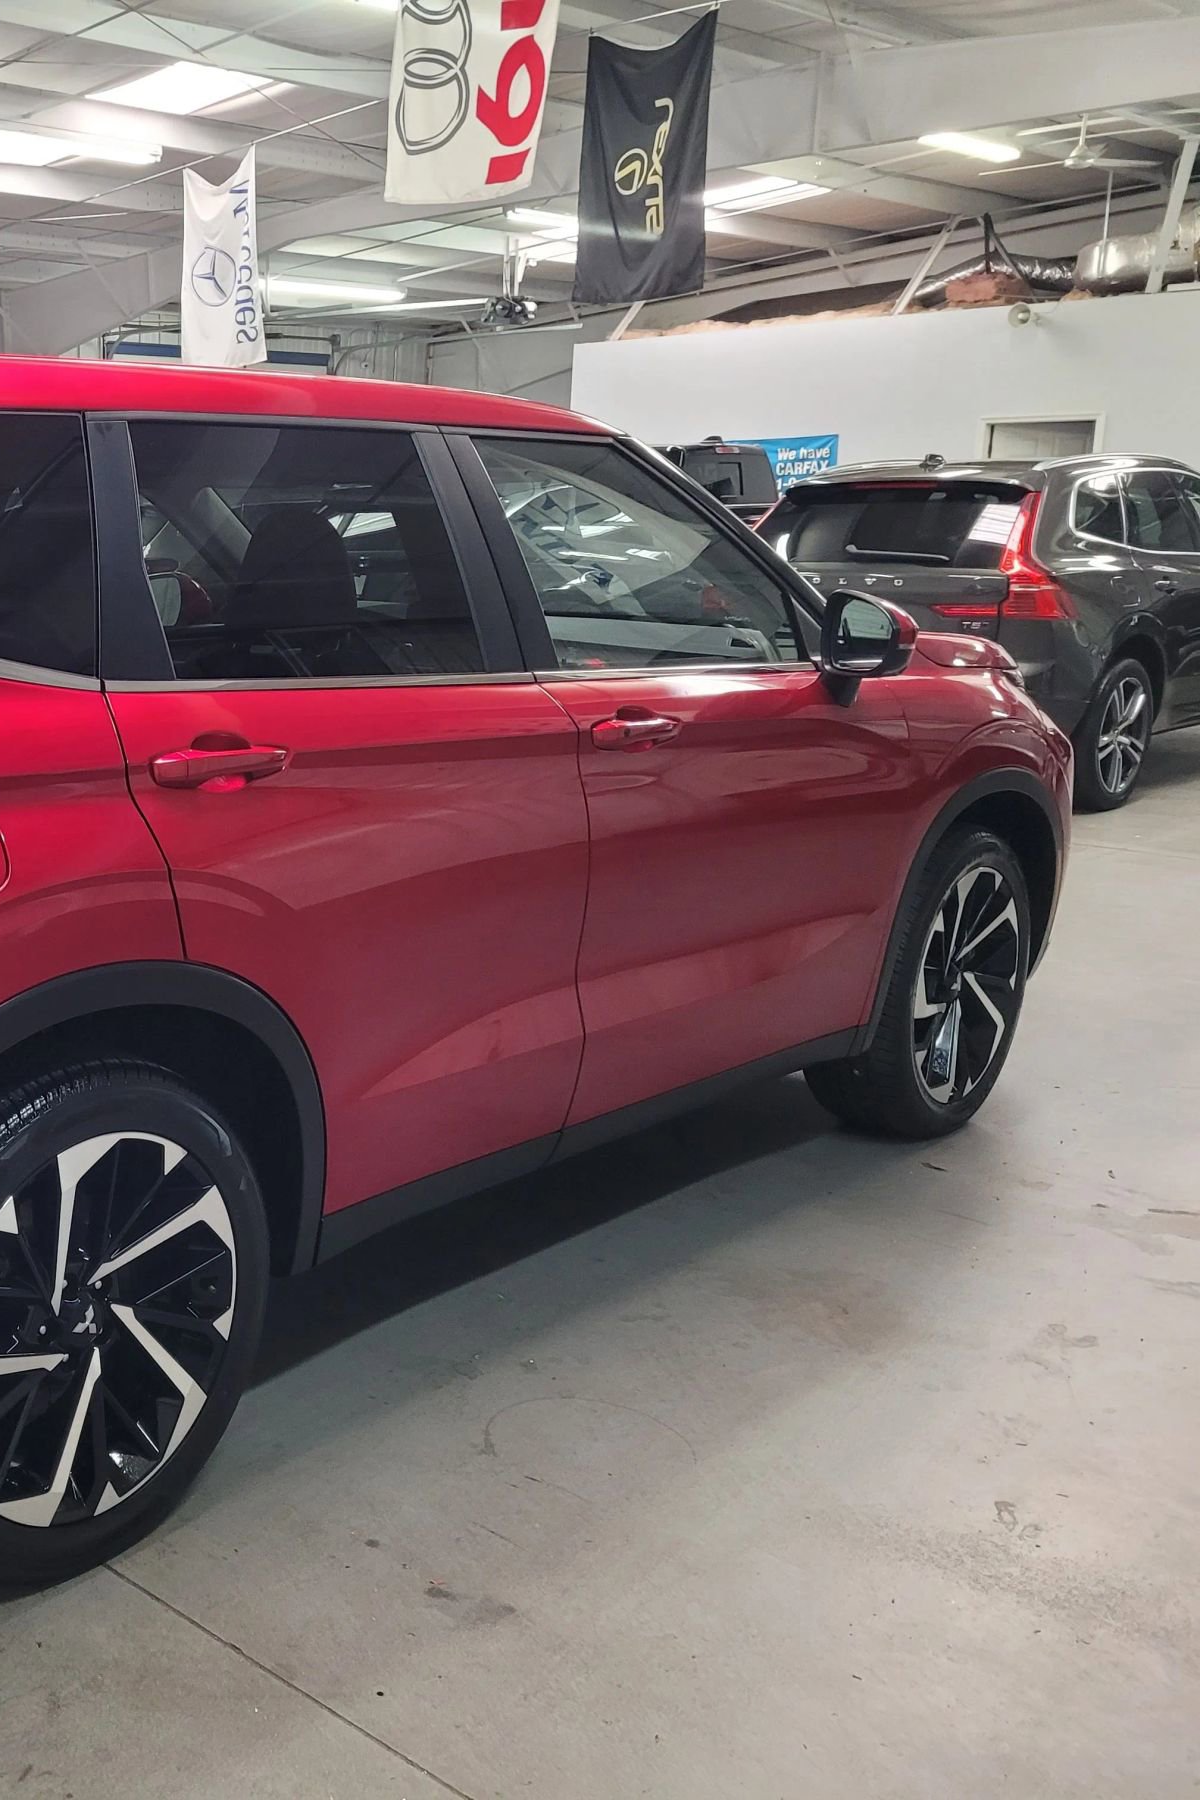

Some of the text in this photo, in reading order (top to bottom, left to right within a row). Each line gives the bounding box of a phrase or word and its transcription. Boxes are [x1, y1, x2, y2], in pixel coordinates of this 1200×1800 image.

[777, 446, 831, 461] We have
[812, 577, 904, 587] OLVO
